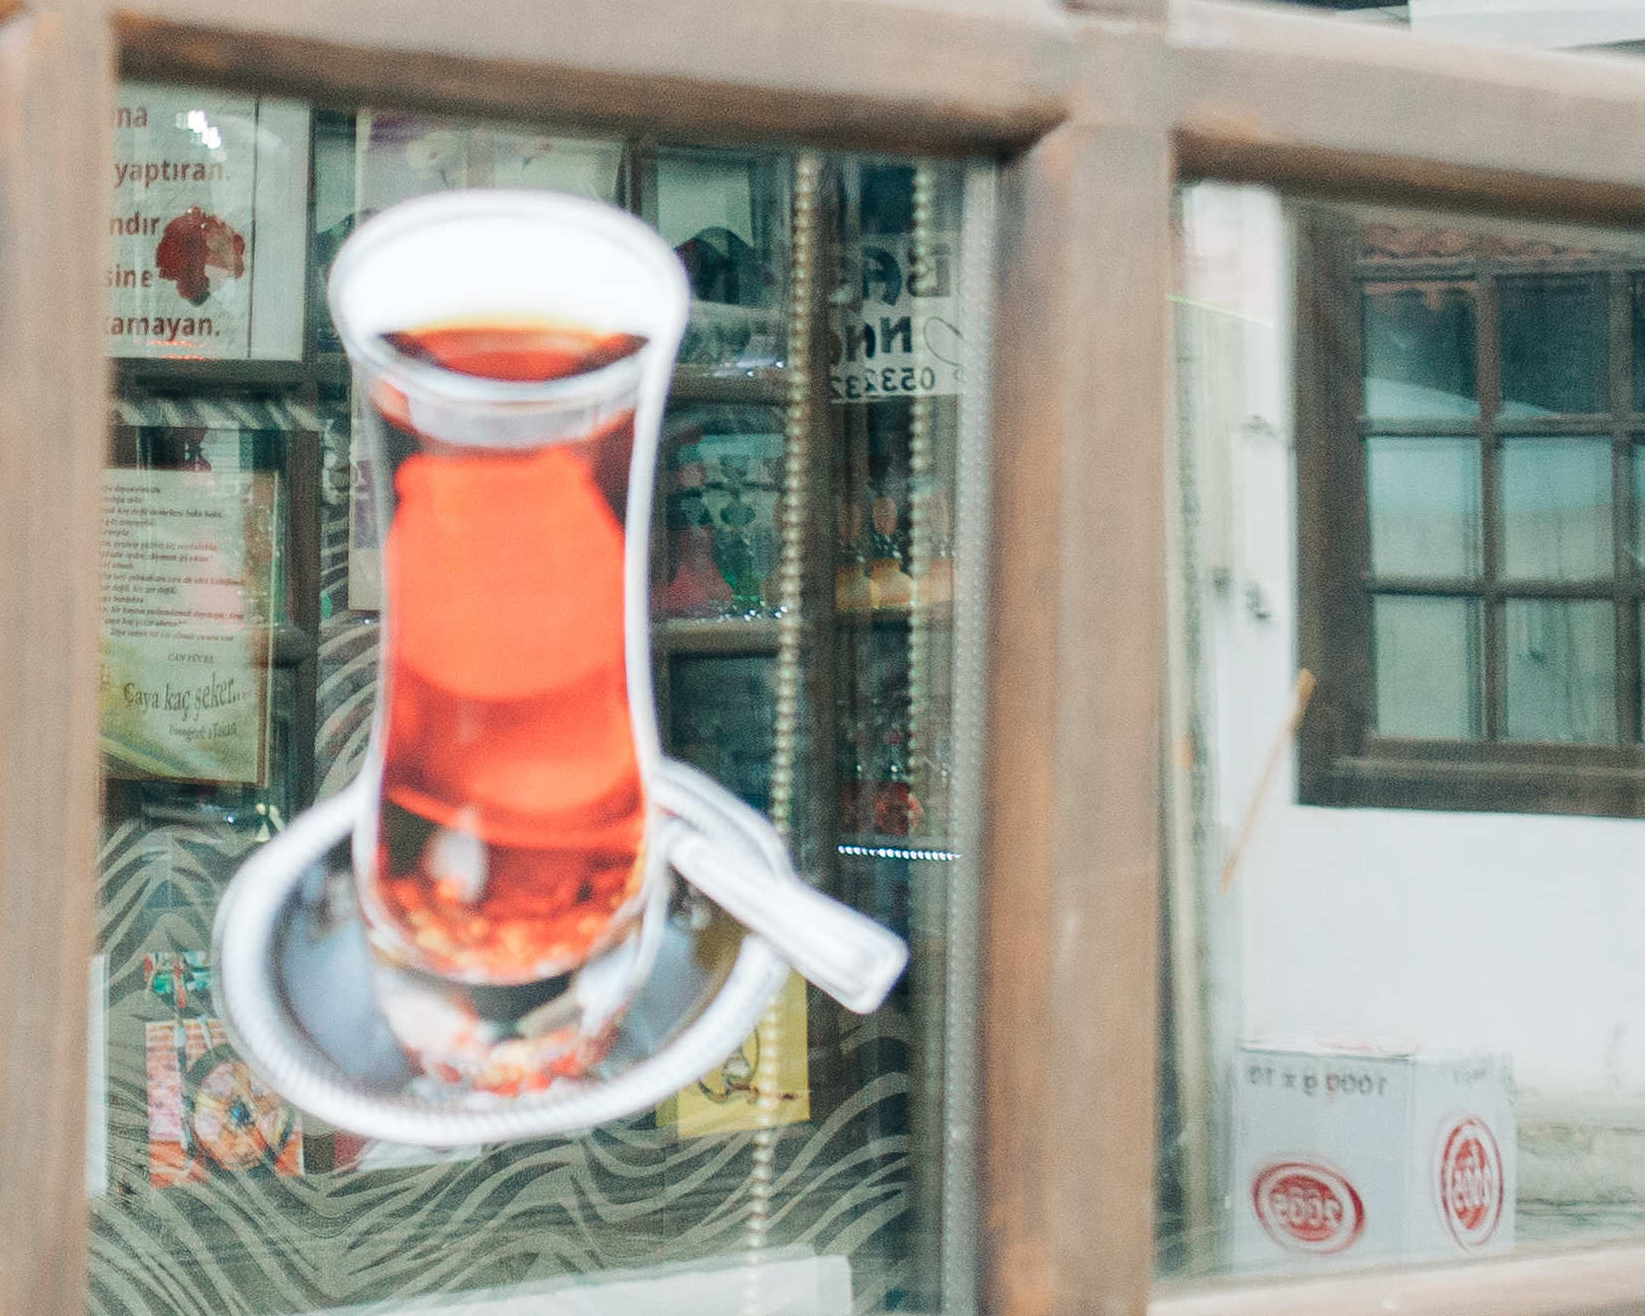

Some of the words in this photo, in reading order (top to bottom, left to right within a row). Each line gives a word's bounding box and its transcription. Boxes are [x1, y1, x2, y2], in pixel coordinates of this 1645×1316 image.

[114, 159, 231, 188] yaptıran.
[124, 682, 160, 714] Çaya
[163, 682, 191, 722] kaç
